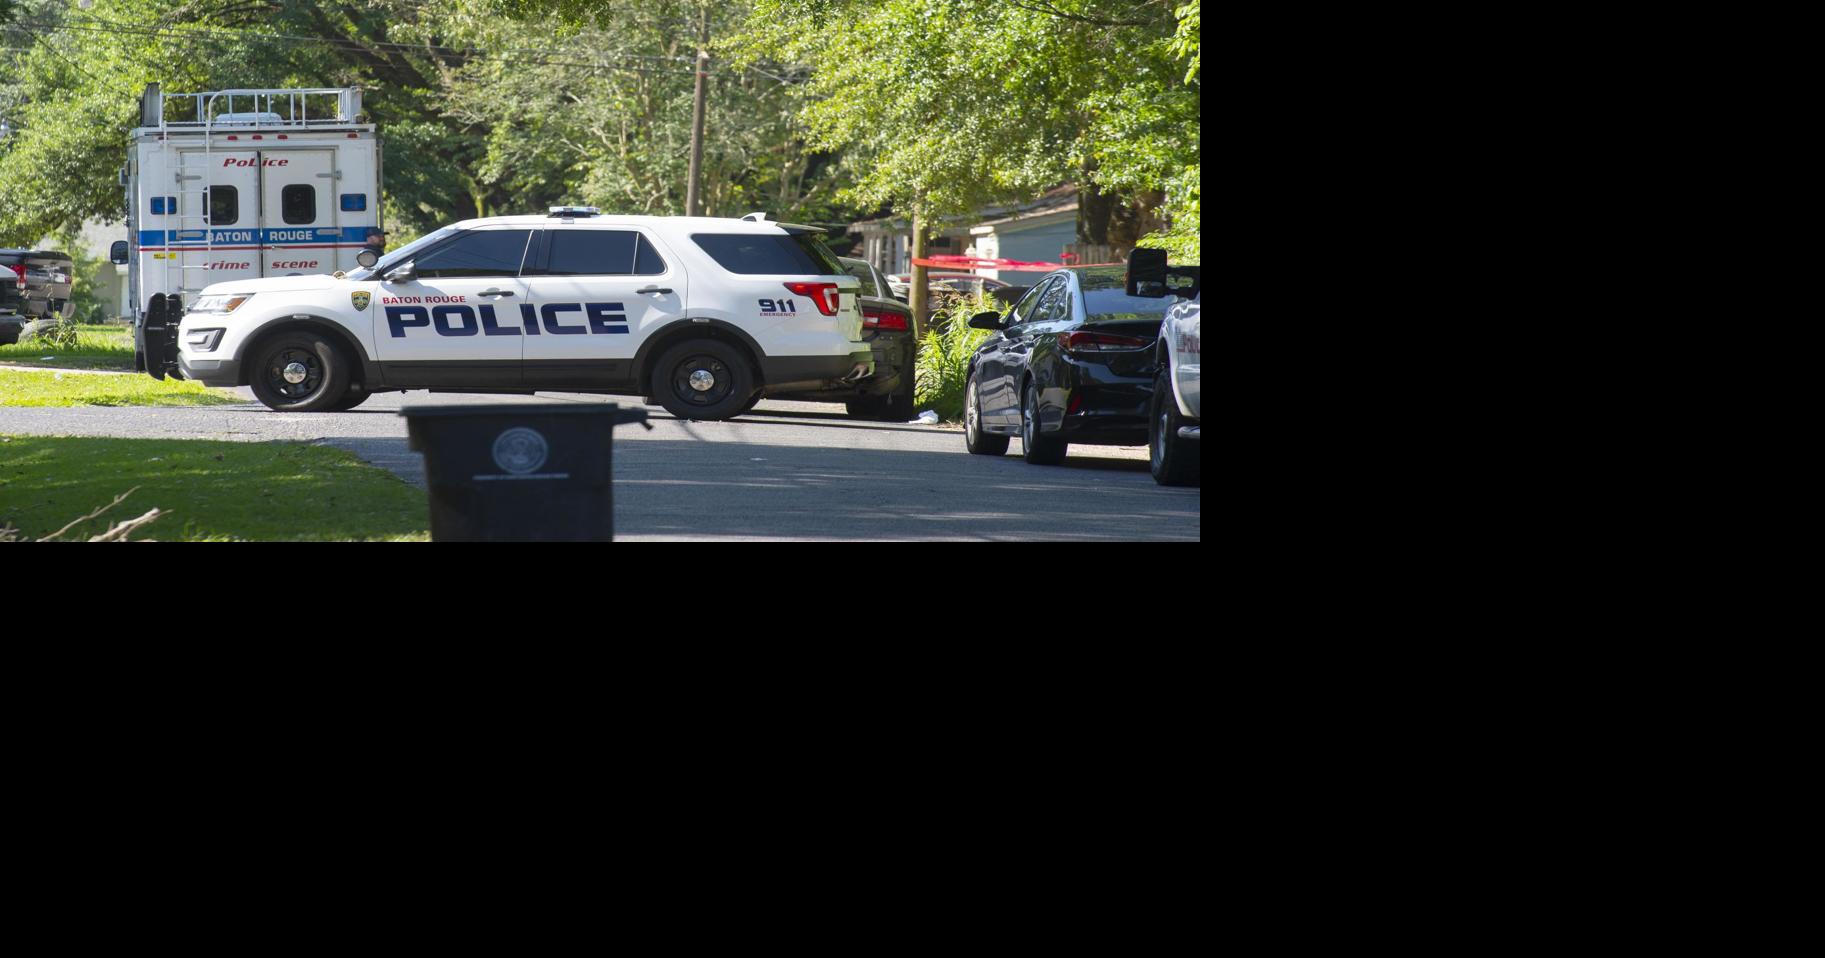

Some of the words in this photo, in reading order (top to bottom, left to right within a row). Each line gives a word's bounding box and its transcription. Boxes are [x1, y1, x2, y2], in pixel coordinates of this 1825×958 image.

[205, 231, 252, 242] BATON
[269, 230, 313, 241] ROUGE
[271, 259, 319, 269] scene
[382, 296, 422, 305] BATON
[424, 295, 467, 304] ROUGE
[758, 298, 796, 313] 911
[384, 302, 630, 338] POLICE
